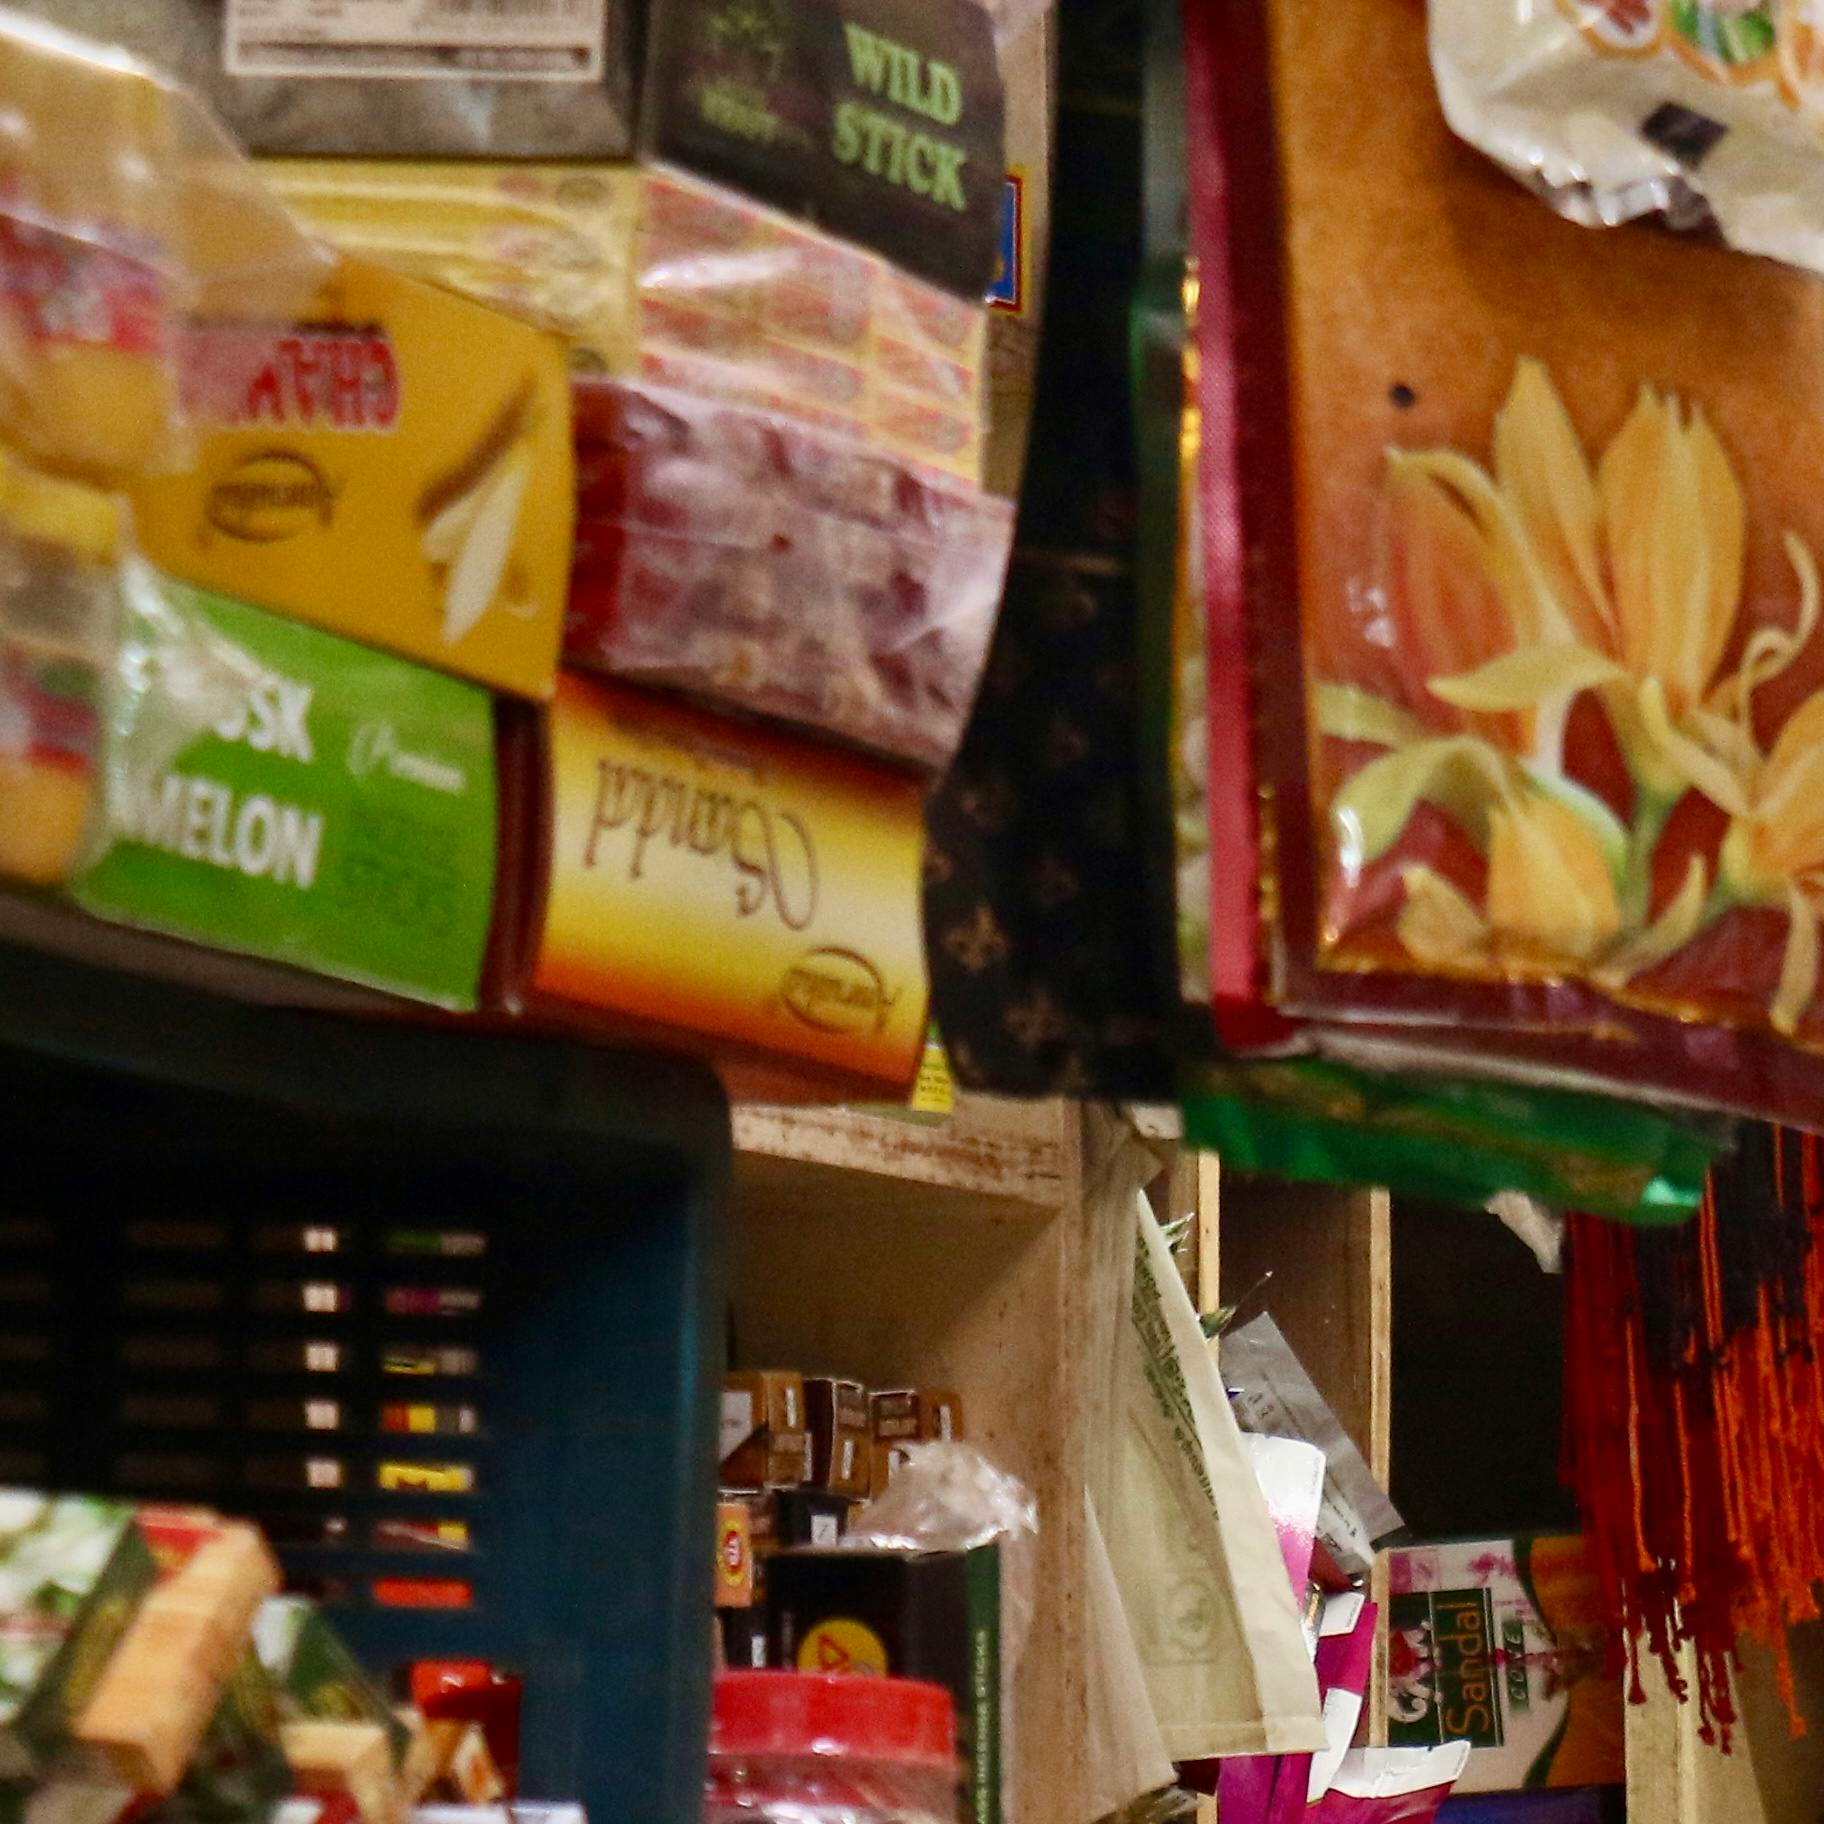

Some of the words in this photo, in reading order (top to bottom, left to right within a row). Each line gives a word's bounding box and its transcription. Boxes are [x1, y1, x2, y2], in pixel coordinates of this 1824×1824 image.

[842, 21, 962, 127] WILD
[832, 103, 968, 213] STICK
[1438, 1601, 1489, 1734] Sandal
